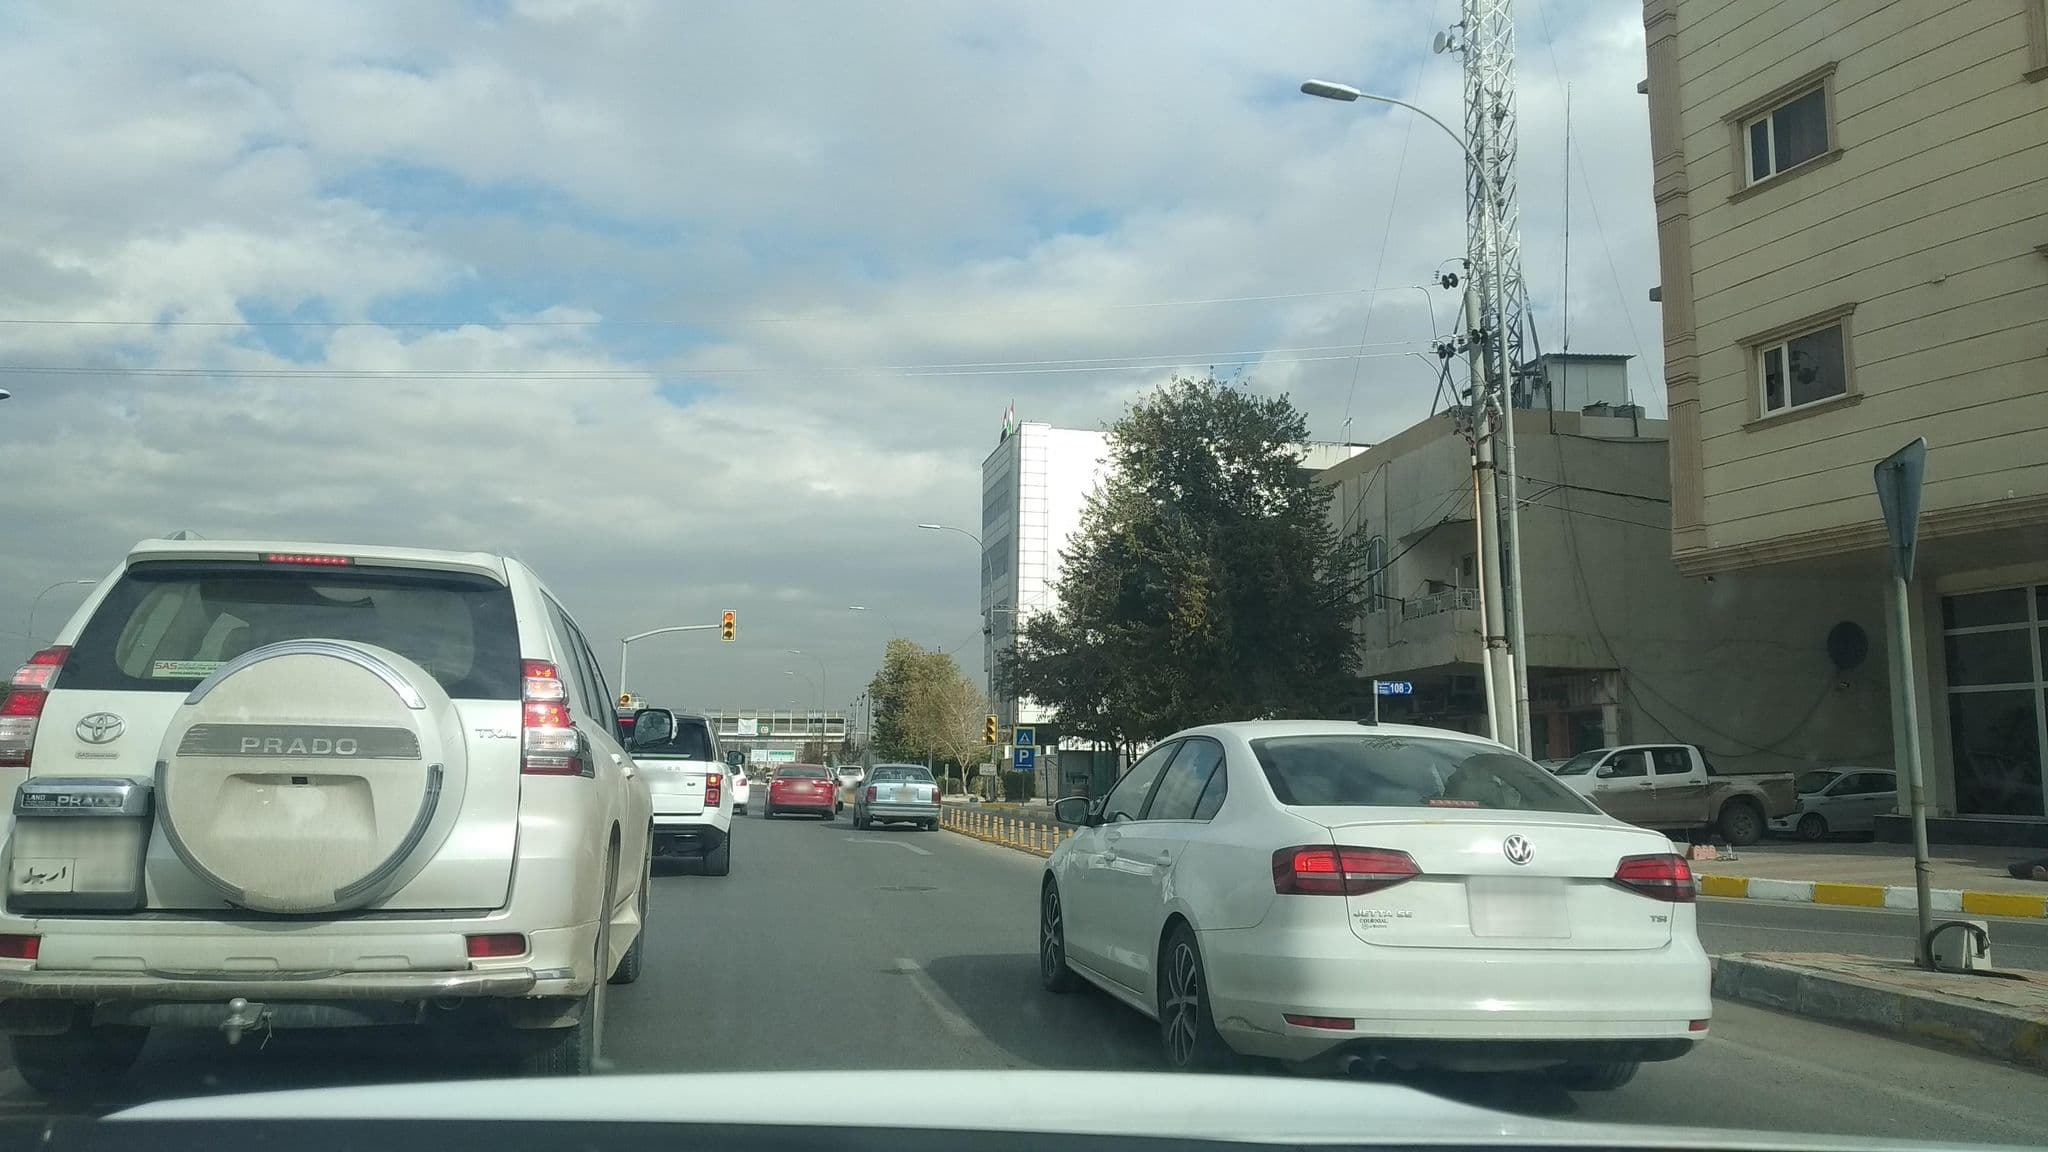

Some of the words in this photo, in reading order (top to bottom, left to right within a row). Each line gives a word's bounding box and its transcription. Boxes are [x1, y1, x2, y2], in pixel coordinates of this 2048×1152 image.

[154, 662, 177, 670] SAS
[1390, 682, 1405, 694] 108
[240, 737, 358, 755] PRADO
[1019, 749, 1030, 763] P
[1353, 909, 1393, 918] JETTA
[1396, 910, 1412, 918] SE
